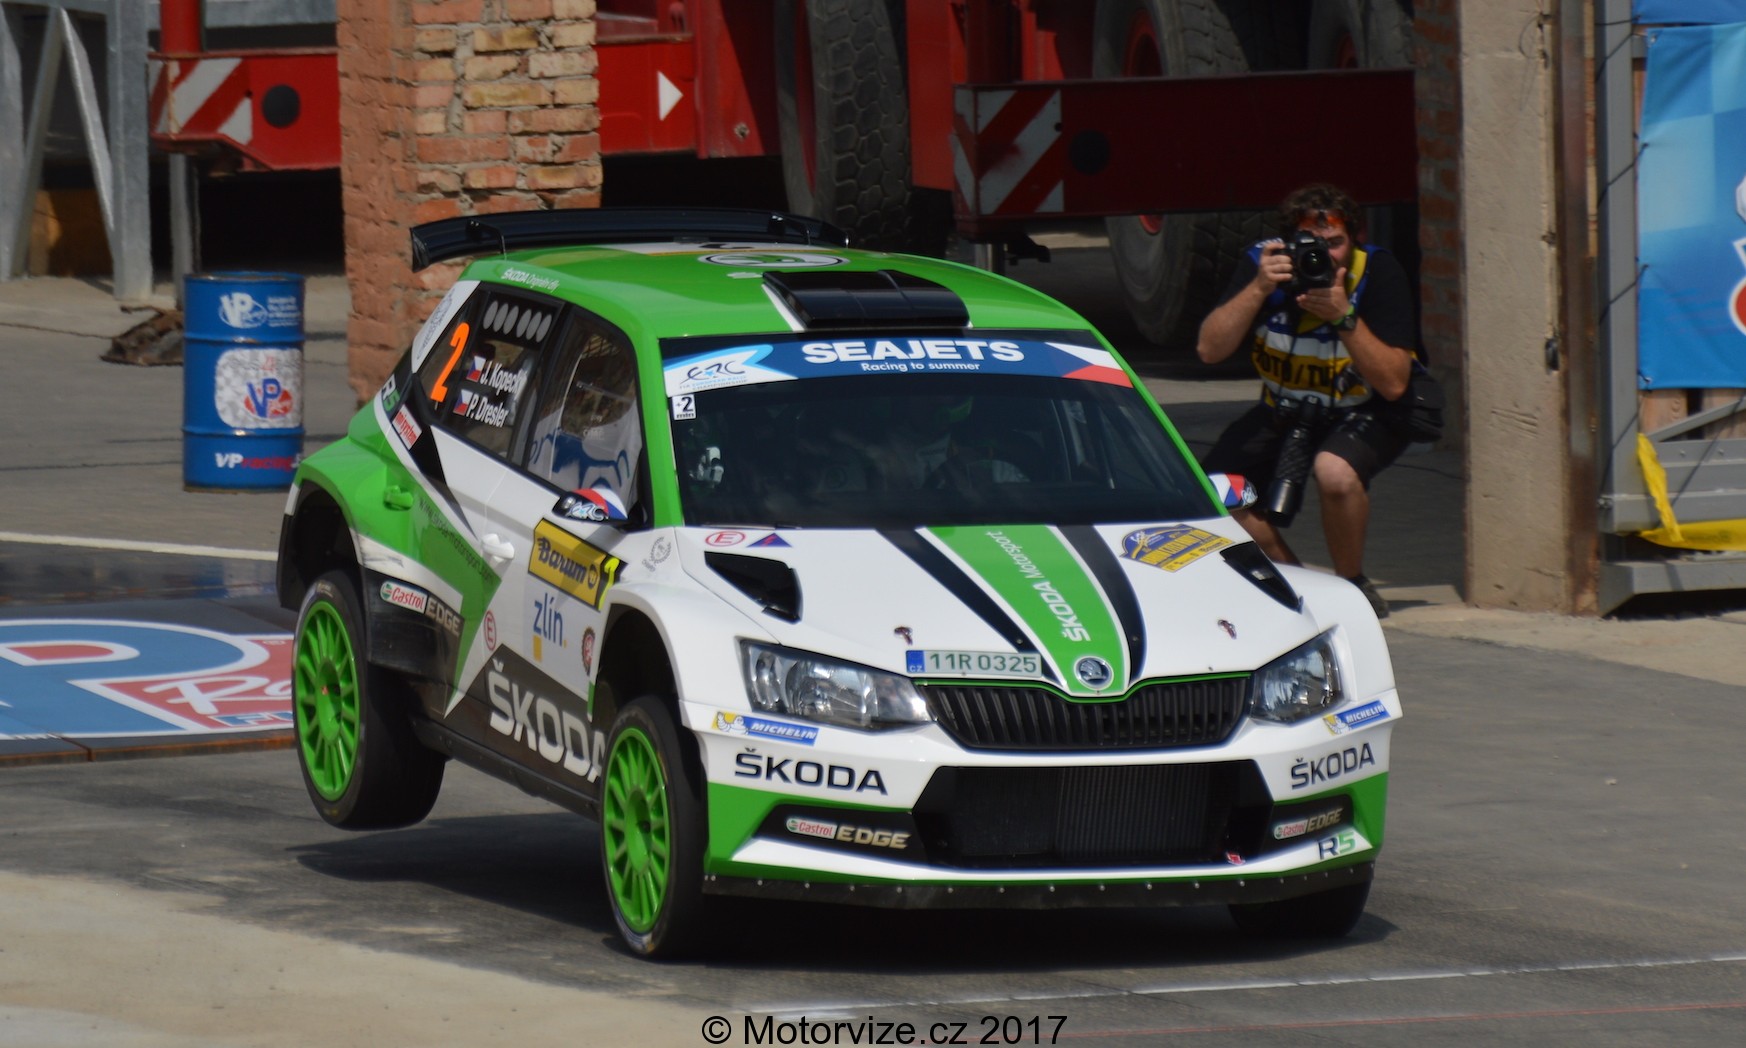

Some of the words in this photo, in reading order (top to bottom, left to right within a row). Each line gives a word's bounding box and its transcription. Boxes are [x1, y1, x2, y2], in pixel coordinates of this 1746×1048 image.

[430, 322, 470, 403] 2
[802, 340, 1025, 363] SEAJETS
[480, 361, 493, 385] J.
[862, 362, 908, 372] Racing
[911, 361, 925, 371] to
[929, 362, 980, 371] summer
[247, 378, 281, 419] VP
[466, 394, 480, 419] P.
[475, 396, 510, 427] Dresler
[537, 537, 588, 585] Barum
[986, 531, 1045, 580] Motorsport
[392, 587, 424, 610] Castrol
[425, 597, 460, 636] EDGE
[1033, 581, 1091, 642] ŠKODA
[910, 664, 924, 673] CZ
[929, 652, 972, 671] 11R
[977, 654, 1037, 674] 0325
[1346, 704, 1386, 724] MICHELIN
[751, 723, 818, 741] MICHELIN
[735, 747, 888, 796] ŠKODA
[1290, 742, 1376, 790] ŠKODA
[797, 820, 834, 838] Castrol
[836, 825, 912, 849] EDGE
[1283, 823, 1306, 837] Castrol
[1306, 808, 1344, 833] EDGE
[1318, 831, 1356, 860] R5
